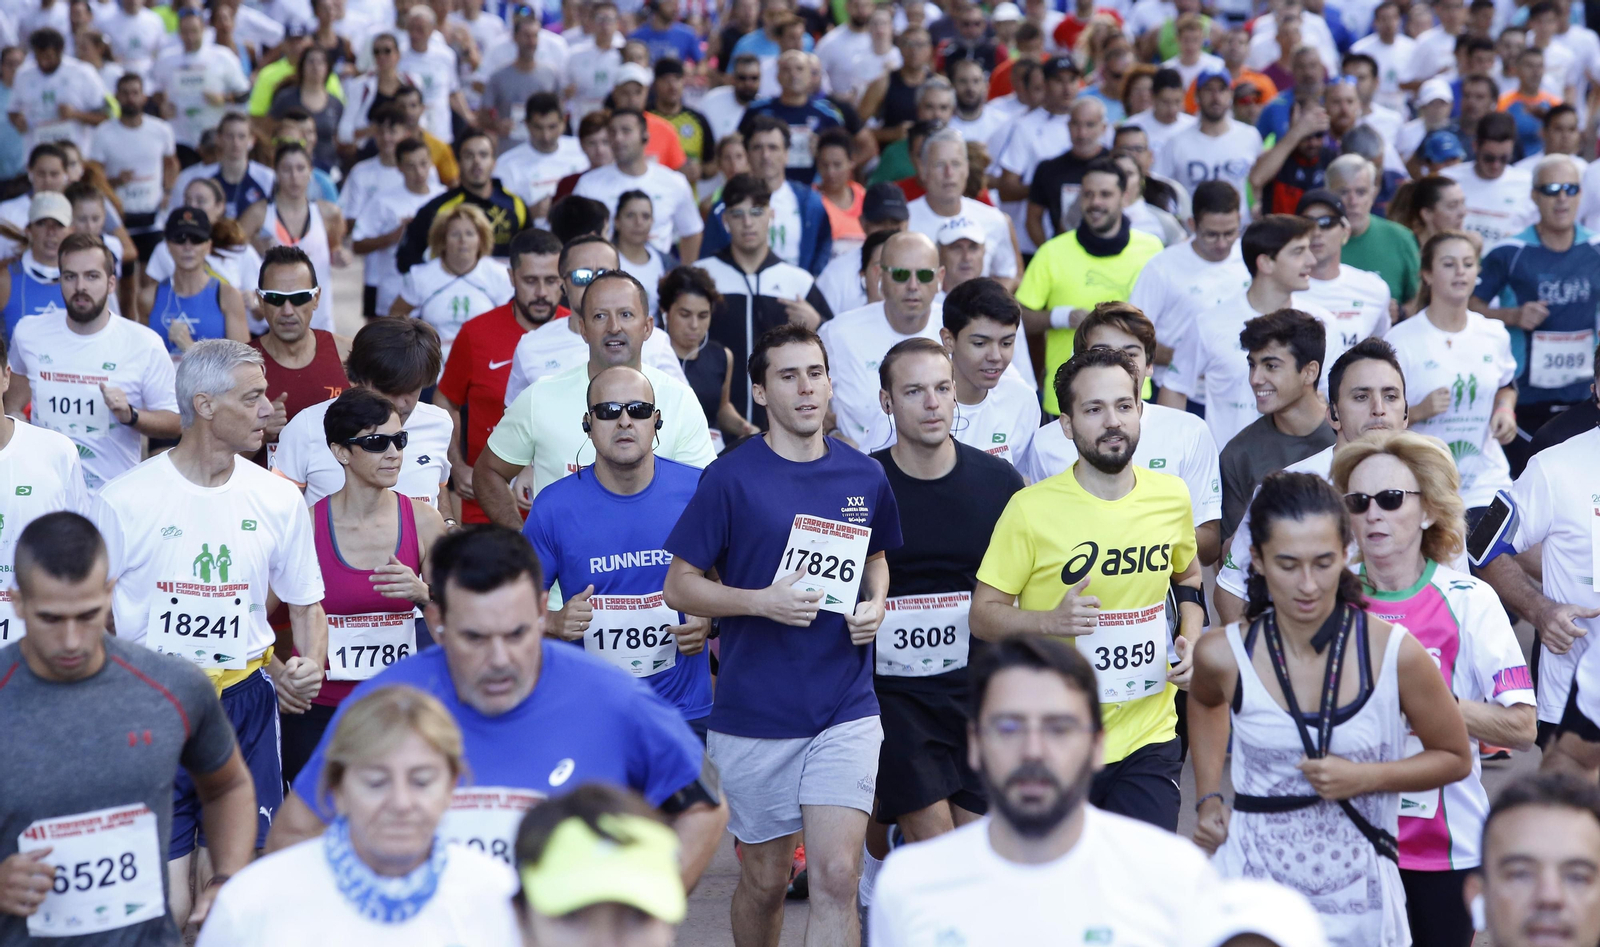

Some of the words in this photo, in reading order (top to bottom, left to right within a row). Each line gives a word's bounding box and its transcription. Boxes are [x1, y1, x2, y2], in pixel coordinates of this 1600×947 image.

[1543, 353, 1586, 369] 3089
[40, 371, 51, 381] 41
[49, 396, 94, 415] 1011
[846, 496, 865, 506] XXX
[794, 517, 802, 529] 41
[803, 517, 835, 529] CARRERA
[836, 524, 869, 538] URBANA
[801, 525, 821, 534] CIUDAD
[785, 547, 856, 583] 17826
[157, 581, 174, 593] 41
[176, 583, 217, 592] CARRERA
[218, 583, 249, 592] URBANA
[176, 589, 201, 597] CIUDAD
[897, 597, 936, 605] CARRERA
[937, 595, 970, 603] URBANA
[328, 616, 344, 628] 41
[346, 614, 383, 623] CARRERA
[385, 612, 414, 620] URBANA
[1098, 611, 1140, 621] CARRERA
[1140, 603, 1164, 617] URBANA
[160, 611, 239, 638] 18241
[593, 623, 673, 650] 17862
[893, 625, 956, 649] 3608
[336, 643, 409, 668] 17786
[1095, 640, 1155, 671] 3859
[25, 826, 46, 840] 41
[52, 852, 137, 895] 6528
